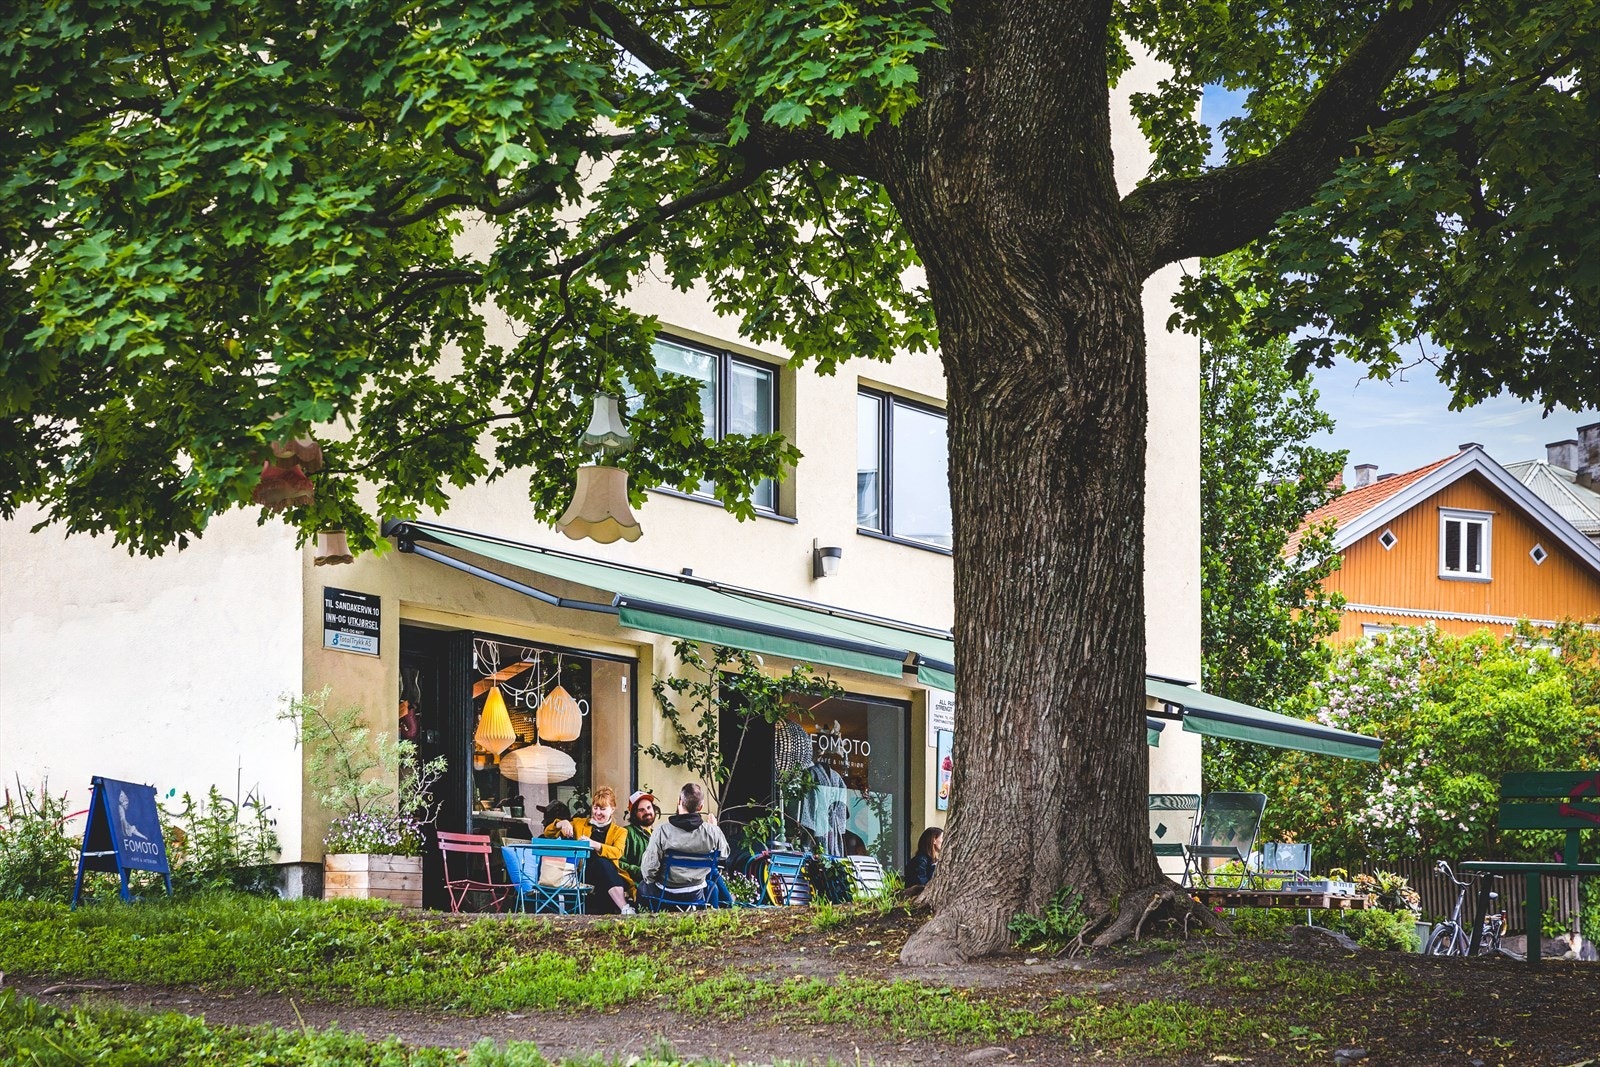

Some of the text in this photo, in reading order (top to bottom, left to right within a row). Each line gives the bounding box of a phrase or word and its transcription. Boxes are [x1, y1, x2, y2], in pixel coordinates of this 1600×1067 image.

[325, 598, 334, 608] TIL
[347, 616, 379, 630] UTKJØRSEL
[515, 689, 589, 716] FOMOO
[810, 733, 871, 757] FOMOTO
[123, 839, 159, 856] FOMOTO
